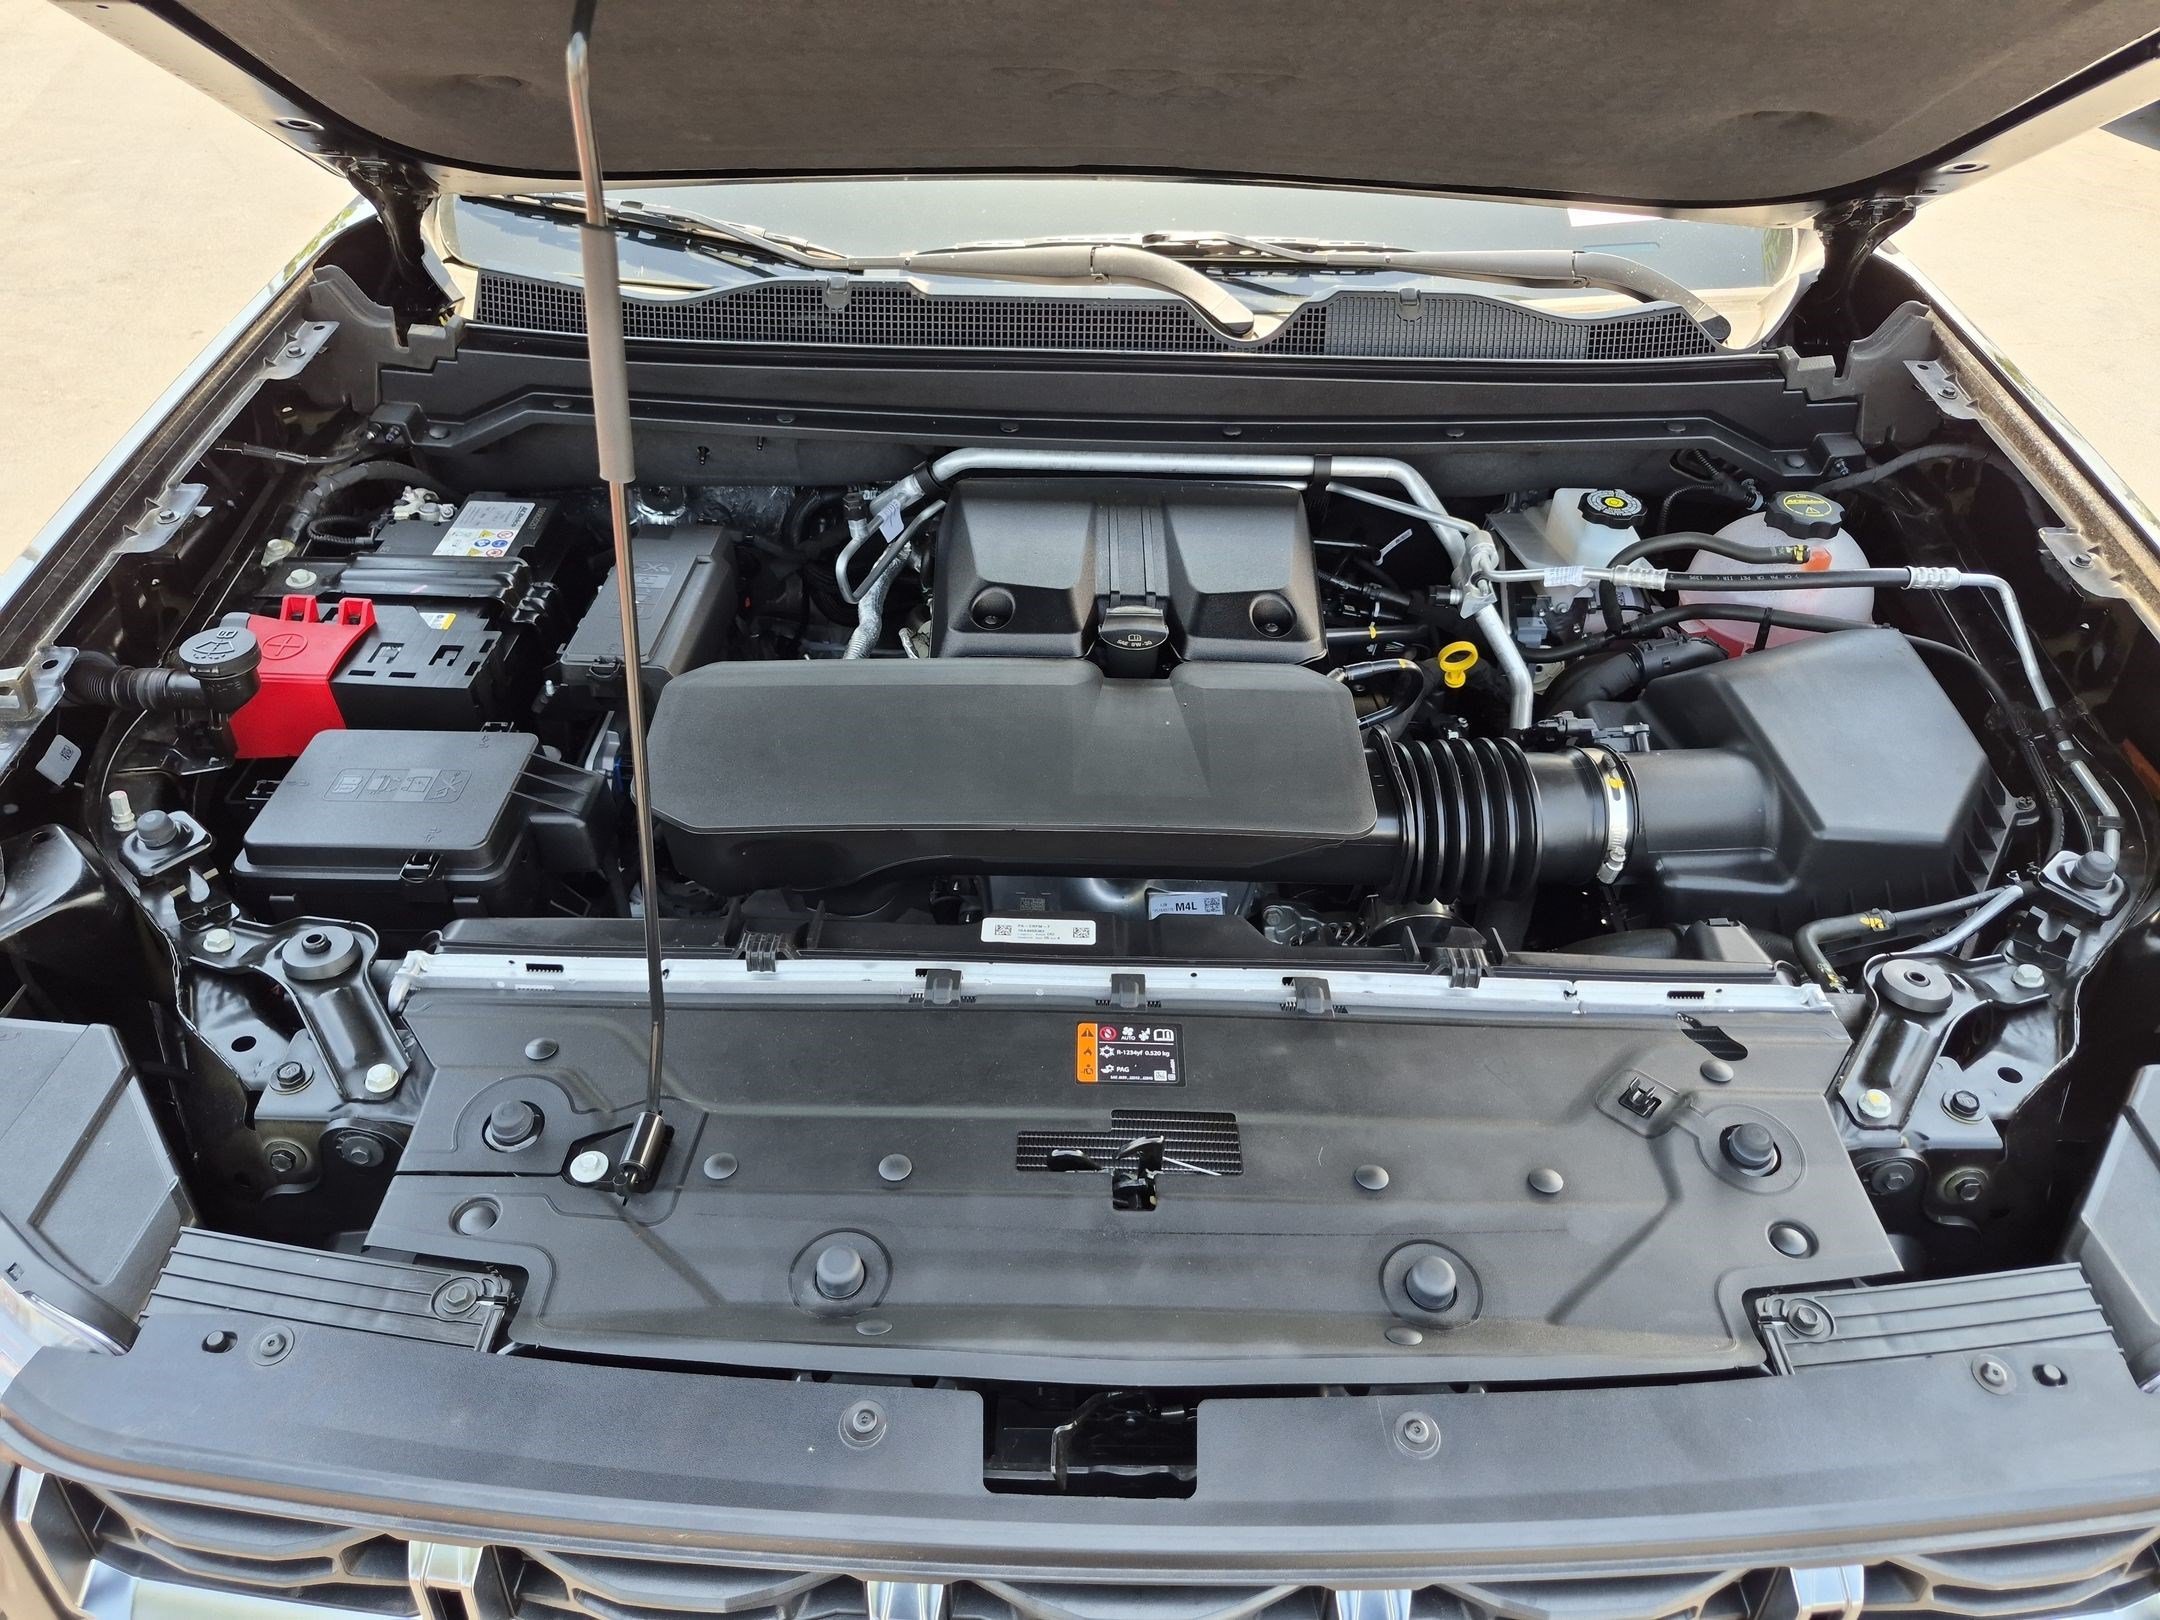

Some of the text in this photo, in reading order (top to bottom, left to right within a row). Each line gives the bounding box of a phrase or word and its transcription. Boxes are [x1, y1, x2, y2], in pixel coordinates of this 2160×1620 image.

[1175, 902, 1197, 912] M4L
[1116, 1049, 1143, 1057] R-1234yf
[1162, 1050, 1170, 1058] kg
